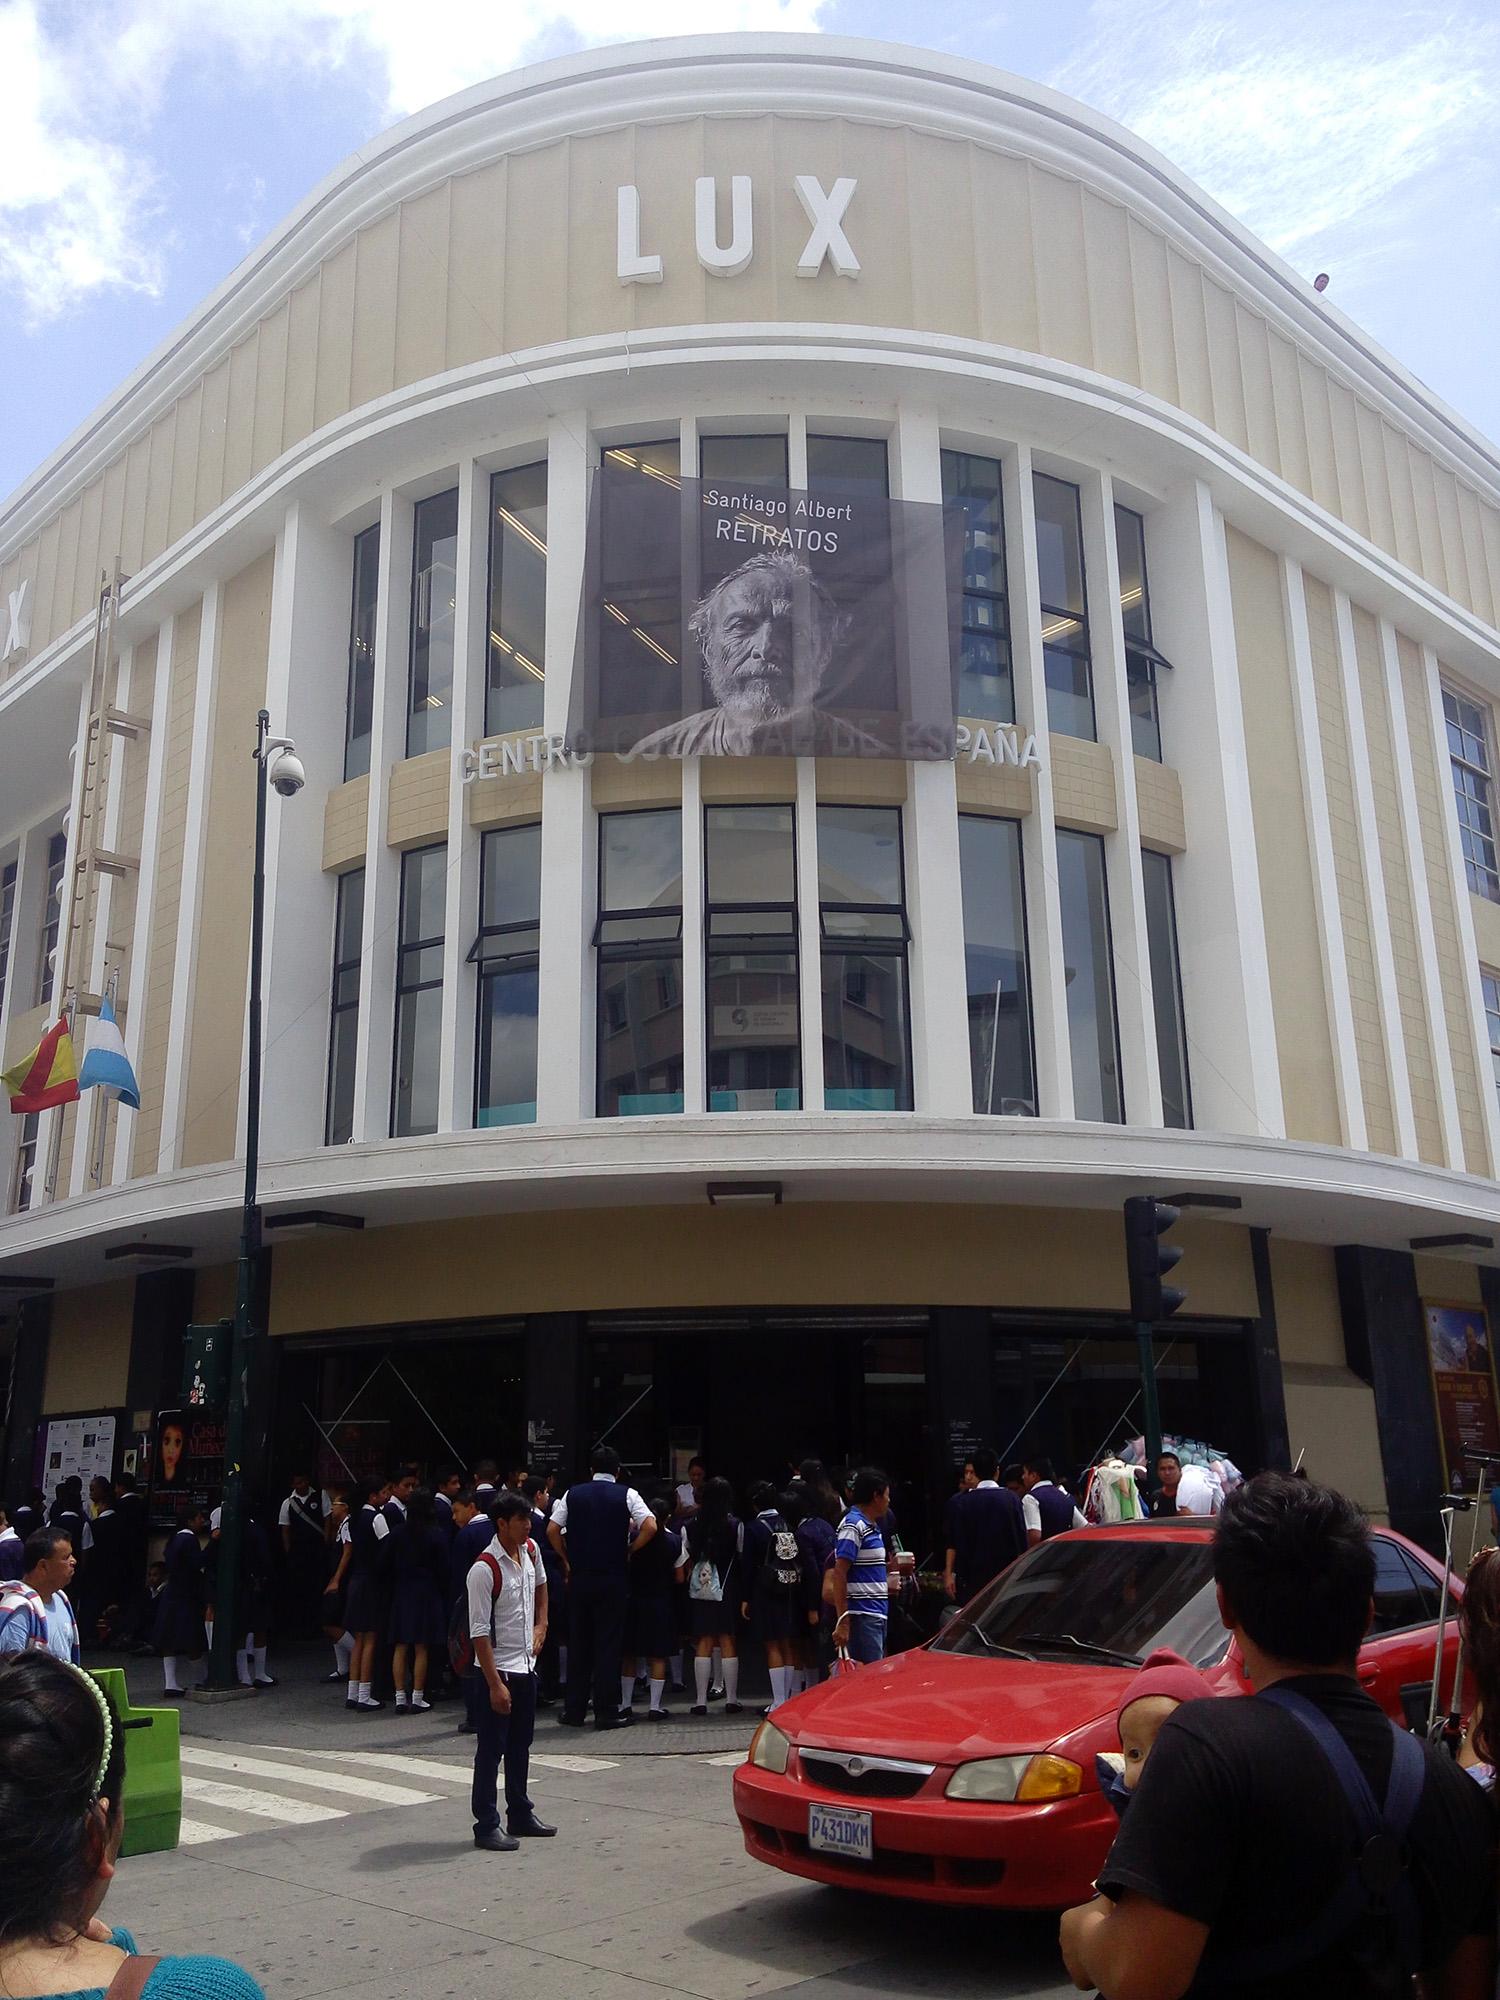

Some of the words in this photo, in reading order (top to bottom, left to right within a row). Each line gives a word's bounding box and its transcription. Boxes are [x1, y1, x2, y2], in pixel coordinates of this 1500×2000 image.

[617, 176, 862, 283] LUX
[708, 489, 787, 518] Santiago
[795, 499, 853, 521] Albert
[715, 519, 839, 554] RETRATOS
[458, 730, 595, 785] CENTRO
[813, 1816, 868, 1848] P431DKM
